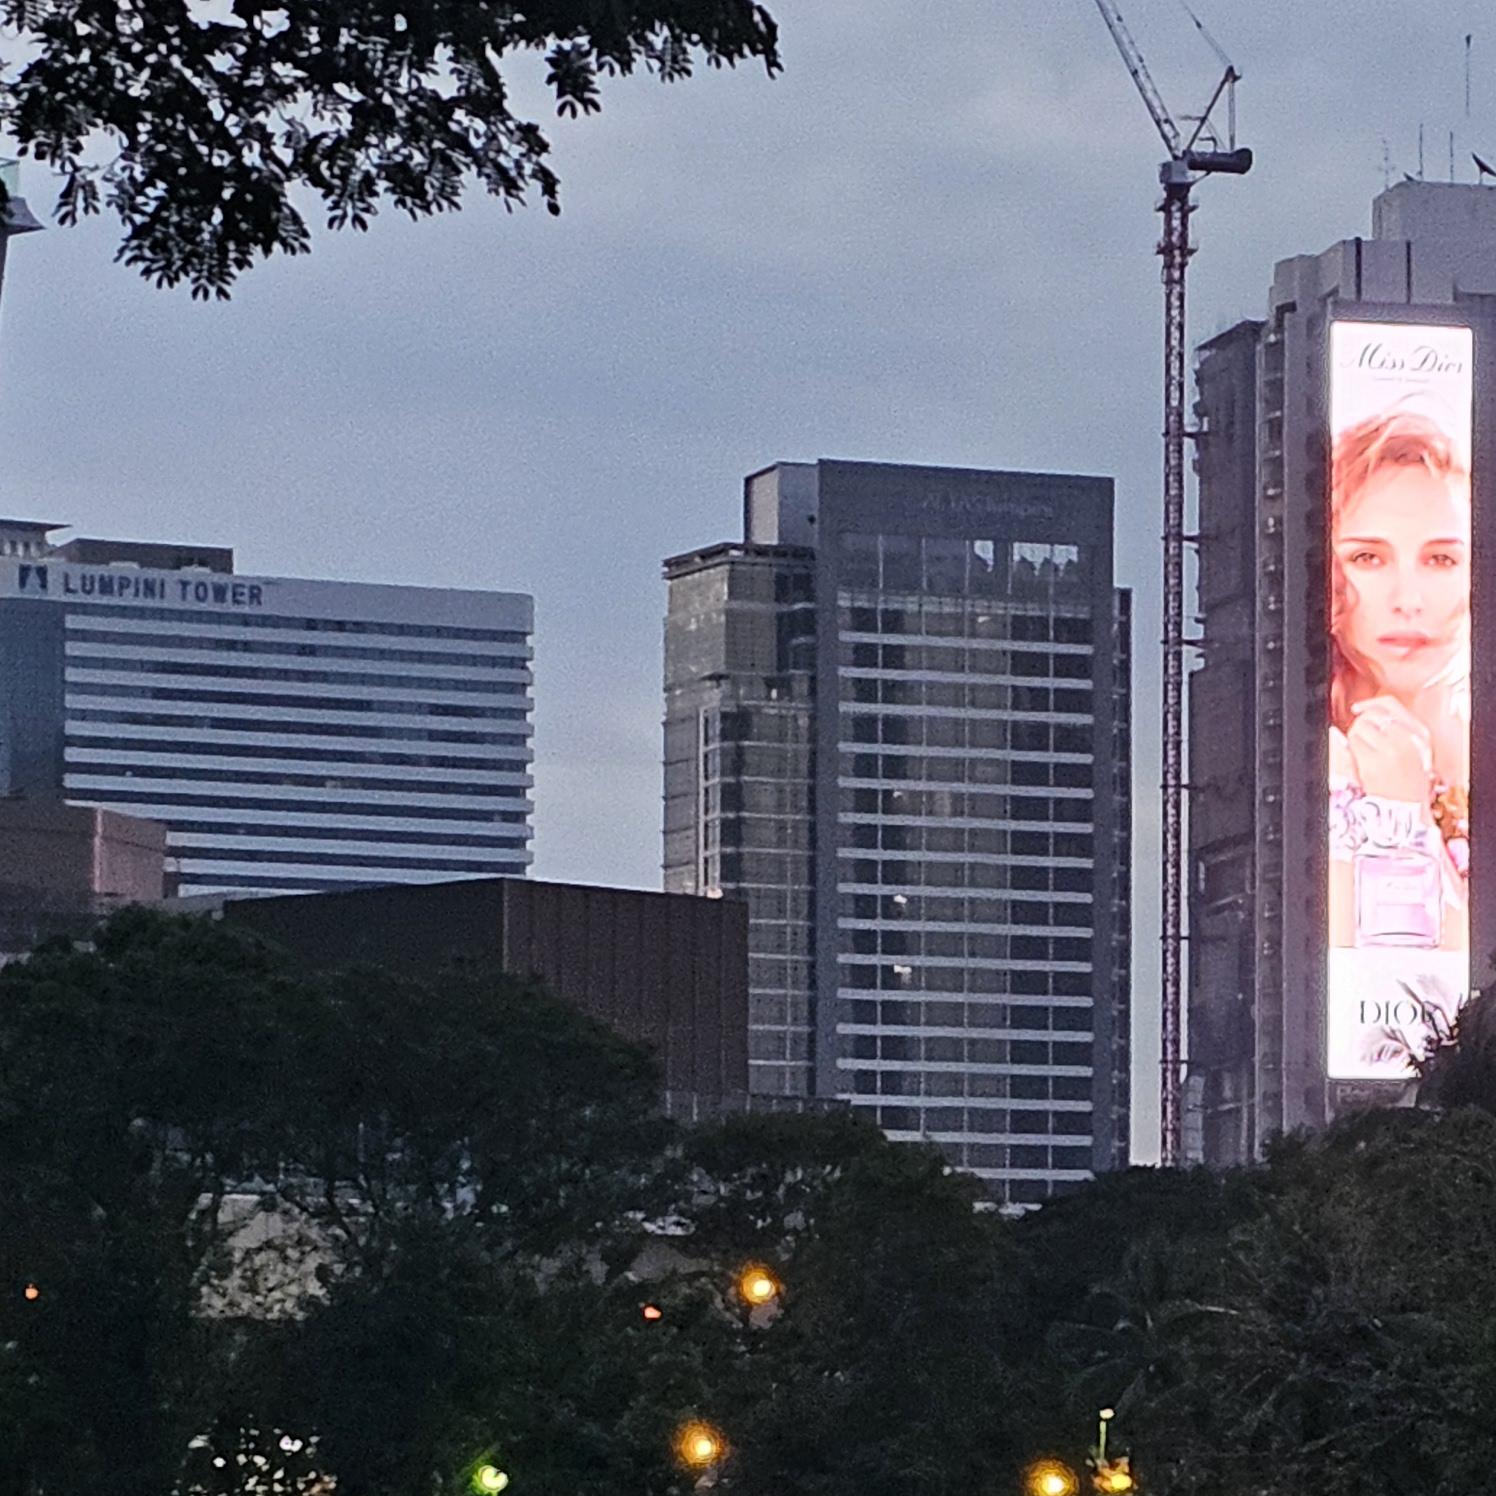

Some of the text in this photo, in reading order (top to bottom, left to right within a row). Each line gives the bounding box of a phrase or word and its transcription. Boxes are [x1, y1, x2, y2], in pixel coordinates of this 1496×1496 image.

[1338, 342, 1463, 374] Miss Dior
[63, 571, 263, 606] LUMPINI TOWER
